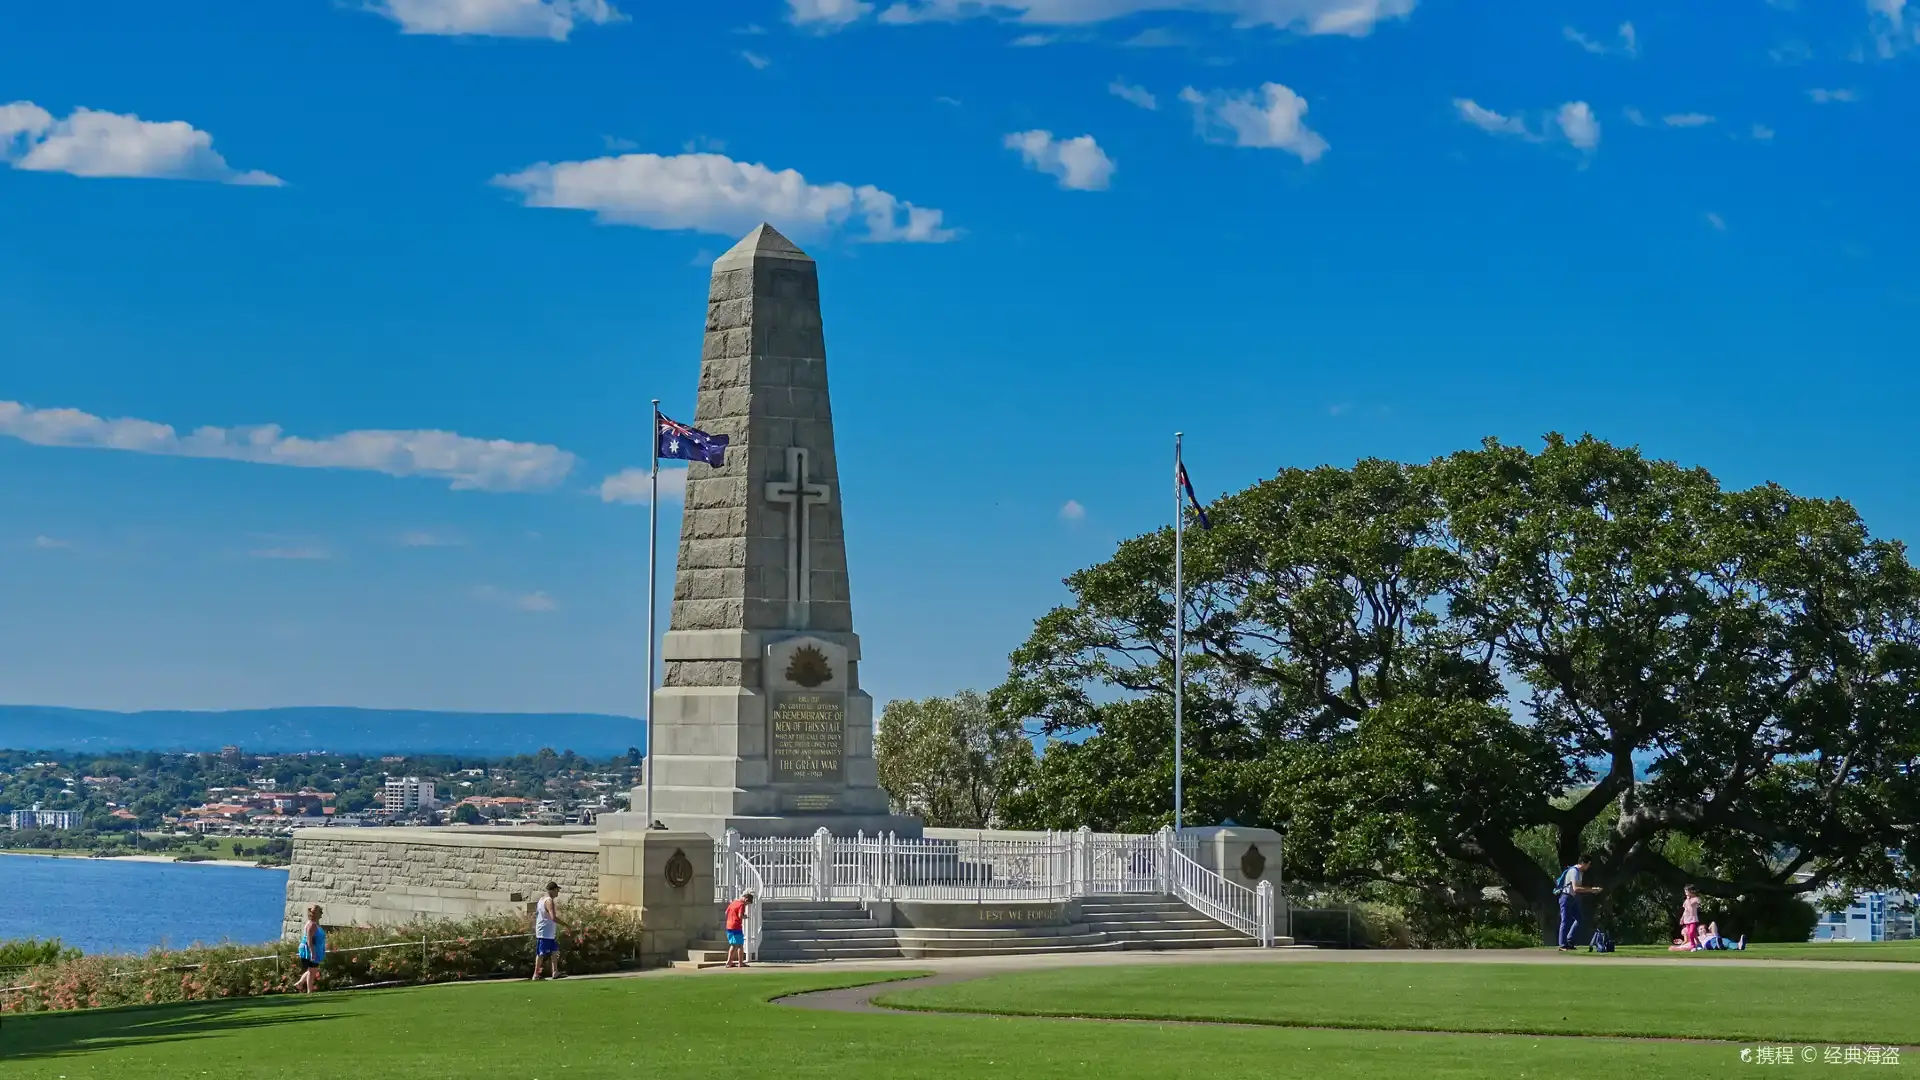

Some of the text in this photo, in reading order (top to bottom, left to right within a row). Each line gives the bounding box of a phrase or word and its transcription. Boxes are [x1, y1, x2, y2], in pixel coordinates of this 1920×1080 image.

[773, 710, 844, 720] IN REMEMBRANCE OF
[775, 721, 842, 732] MEN OF THIS STATE
[780, 760, 838, 770] THE GREAT WAR
[980, 910, 1004, 920] LEST
[1009, 910, 1023, 920] WE
